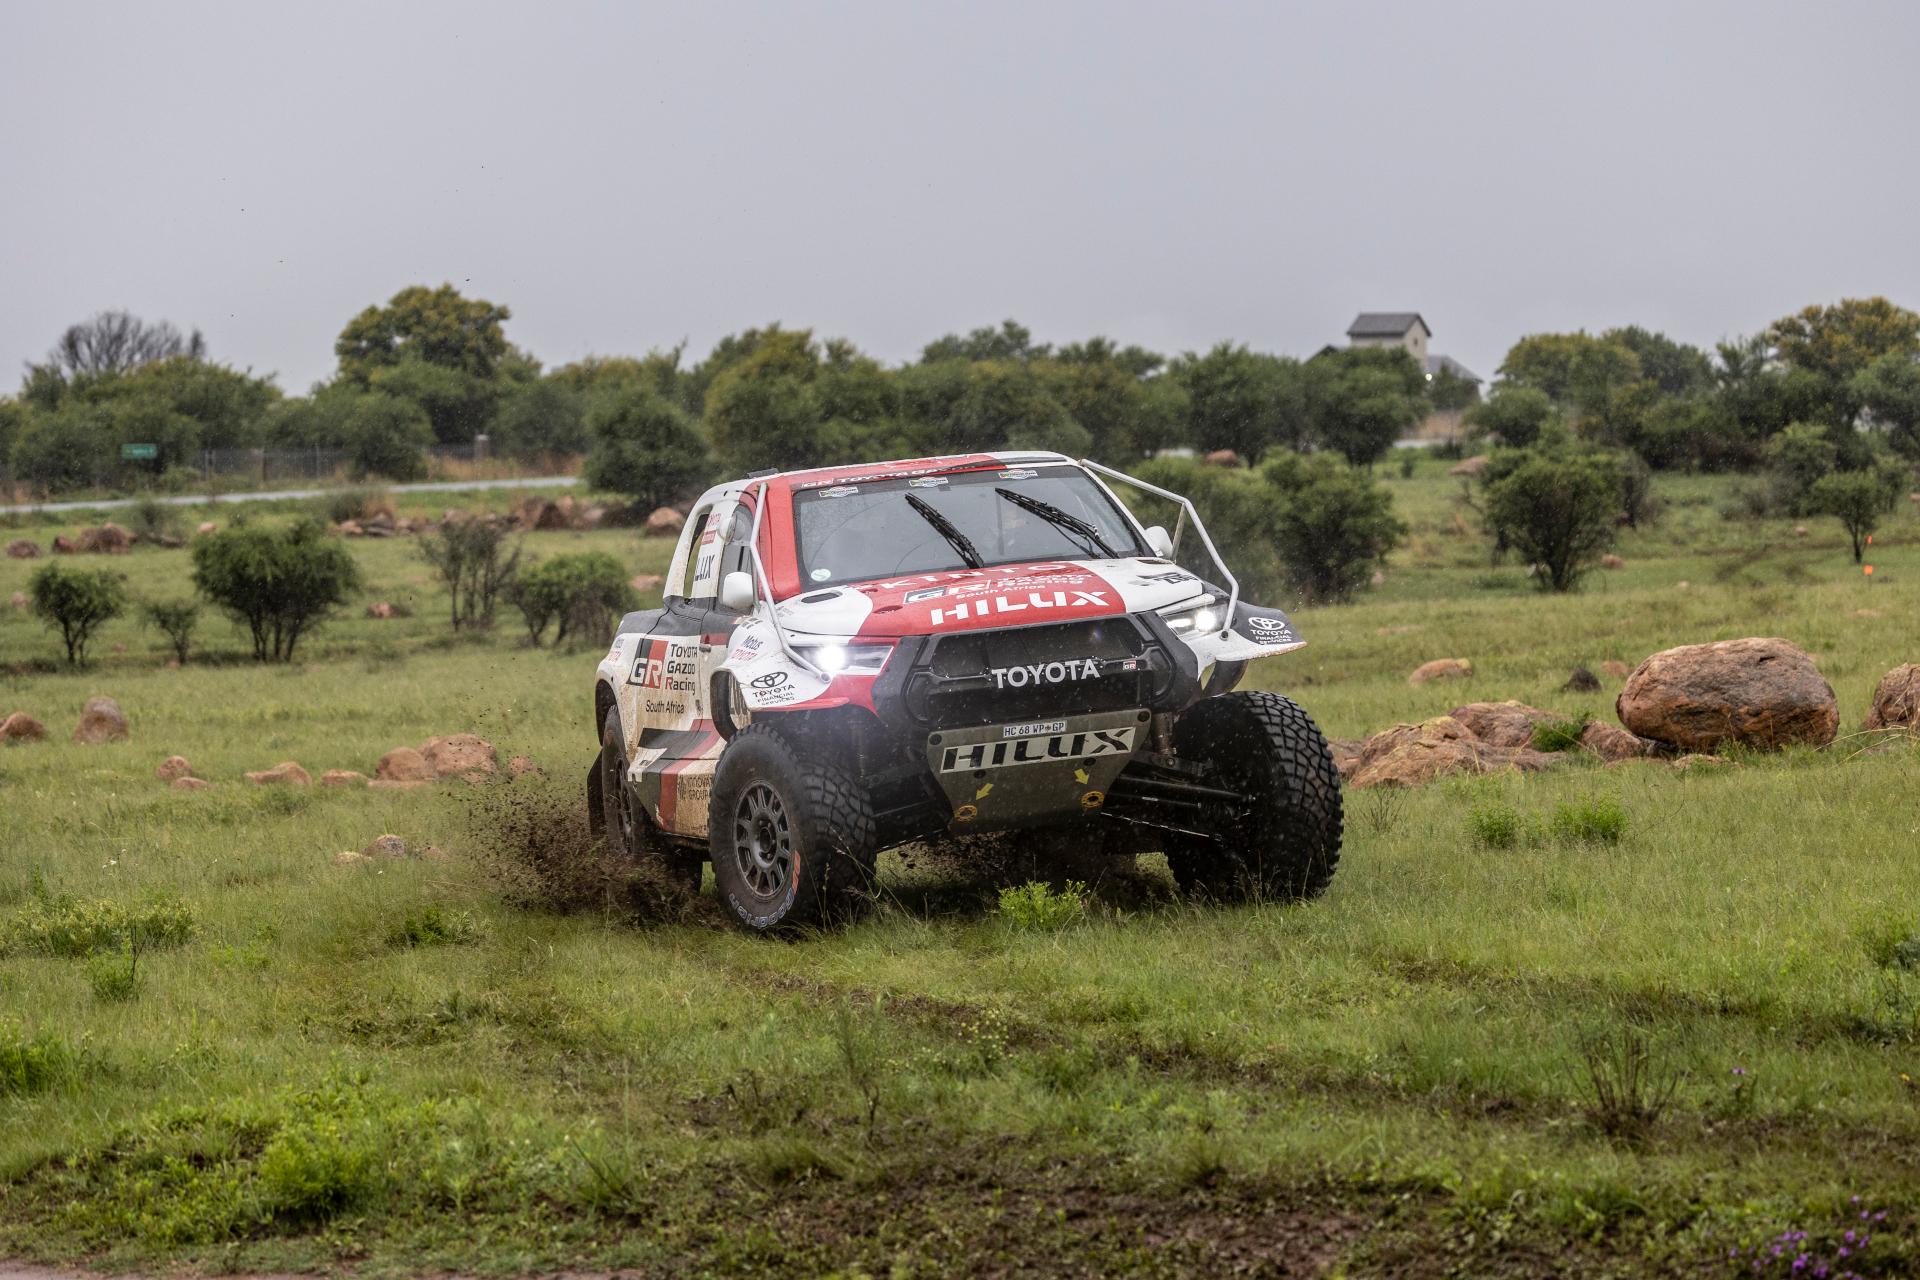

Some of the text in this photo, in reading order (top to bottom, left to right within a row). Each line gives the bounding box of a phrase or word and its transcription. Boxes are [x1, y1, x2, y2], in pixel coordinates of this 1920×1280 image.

[880, 564, 1067, 589] KINTO
[904, 580, 991, 604] GR
[955, 584, 1046, 599] South Africa
[930, 591, 1109, 626] HILUX
[670, 643, 698, 658] TOYOTA
[629, 657, 663, 688] GR
[667, 660, 696, 675] GAZOO
[991, 658, 1101, 689] TOYOTA
[665, 676, 696, 696] Racing
[752, 684, 796, 698] TOYOTA
[757, 691, 794, 703] FINANCIAL
[645, 700, 685, 714] South Africa
[1004, 722, 1065, 737] HC 68 WP GP
[942, 727, 1133, 771] HILUX
